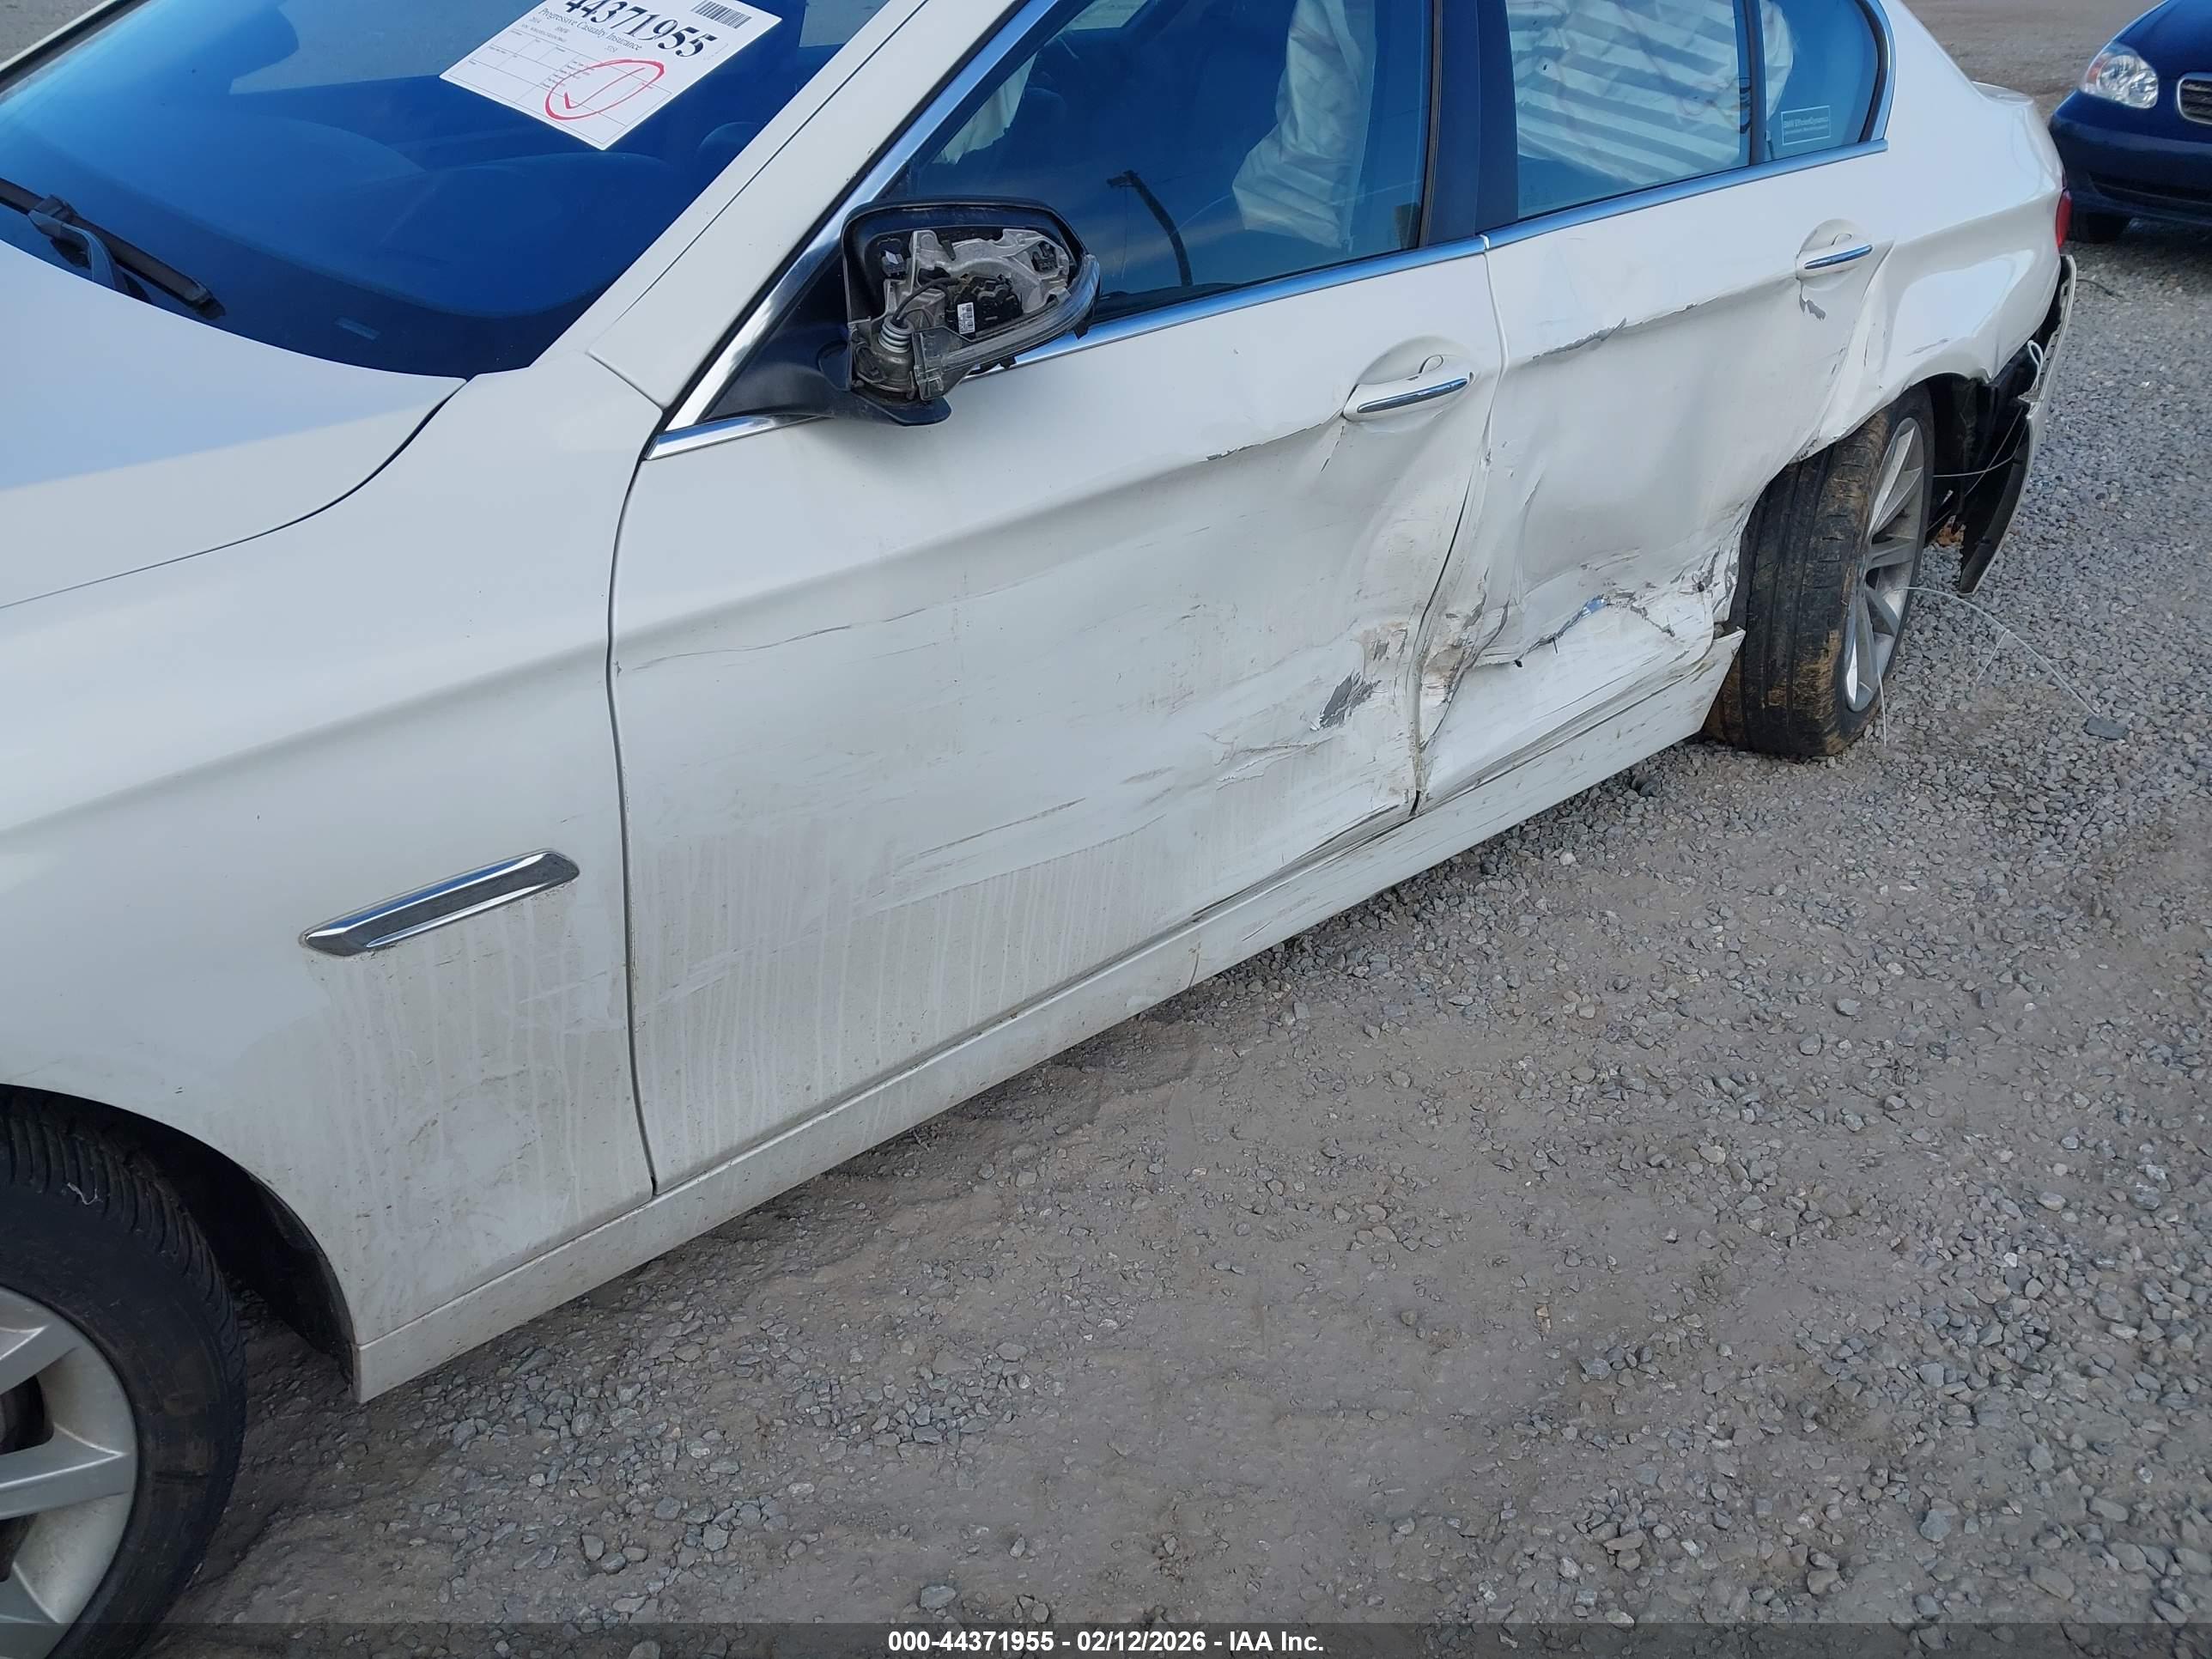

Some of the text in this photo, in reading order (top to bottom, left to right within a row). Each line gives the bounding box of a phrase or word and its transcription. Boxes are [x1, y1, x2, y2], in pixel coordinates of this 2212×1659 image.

[538, 7, 578, 27] Progressive
[576, 21, 605, 39] Casualty
[606, 29, 643, 52] Insurance
